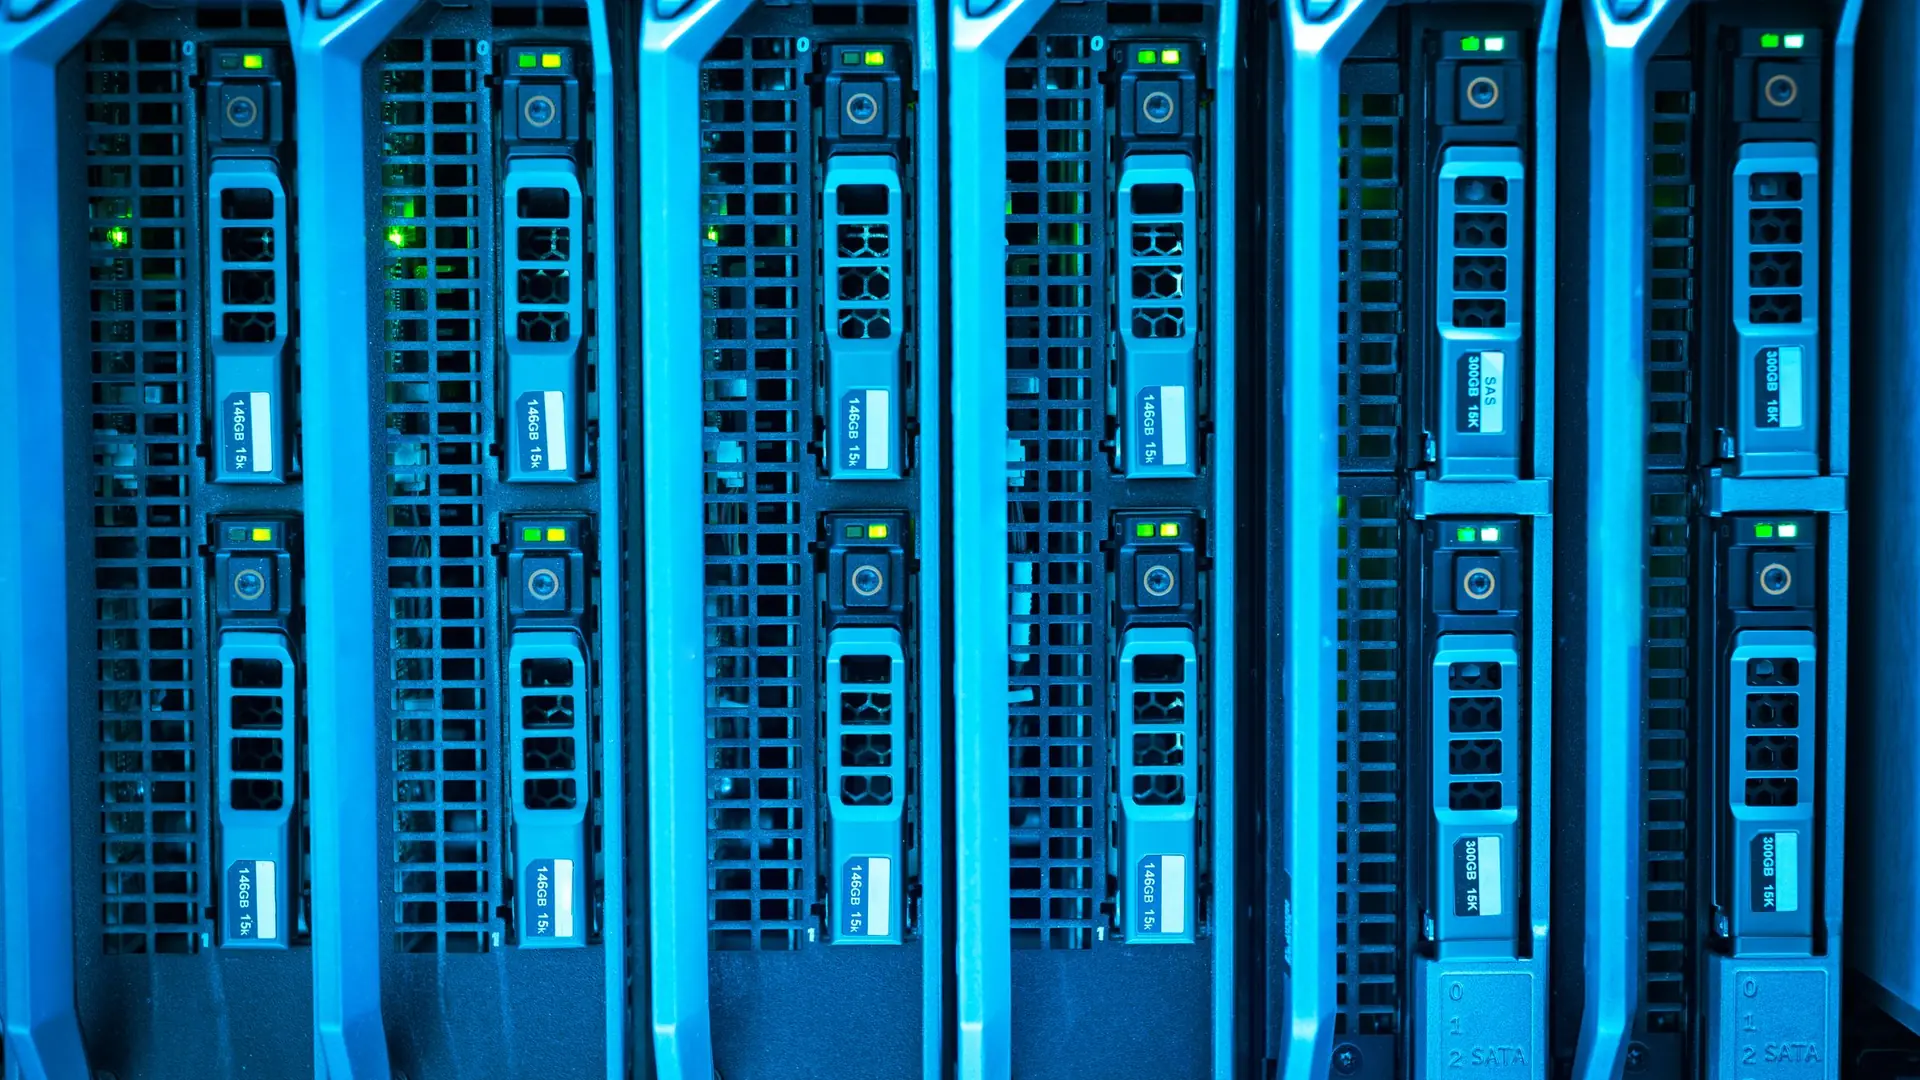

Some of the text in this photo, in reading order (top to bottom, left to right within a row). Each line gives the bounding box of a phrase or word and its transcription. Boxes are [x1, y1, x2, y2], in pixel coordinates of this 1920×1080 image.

[477, 40, 490, 55] 0
[797, 36, 810, 52] 0
[1091, 35, 1104, 51] 0
[1766, 351, 1778, 392] 300GB
[1468, 356, 1479, 428] 300GB 15K
[1484, 376, 1496, 406] SAS
[233, 399, 246, 441] 146GB
[527, 399, 540, 441] 146GB
[848, 397, 860, 439] 146GB
[1143, 394, 1155, 436] 146GB
[1144, 862, 1155, 903] 146GB
[1466, 840, 1478, 911] 300GB 15K
[1763, 836, 1774, 907] 300GB 15K
[238, 867, 250, 908] 146GB
[537, 866, 548, 906] 146GB
[850, 865, 862, 905] 146GB
[201, 932, 209, 947] 1
[491, 931, 500, 947] 1
[807, 927, 815, 942] 1
[1096, 926, 1104, 941] 1
[1449, 981, 1463, 1001] 0
[1743, 977, 1757, 998] 0
[1450, 1016, 1462, 1036] 1
[1743, 1013, 1756, 1033] 1
[1449, 1046, 1527, 1068] 2 SATA
[1742, 1042, 1820, 1064] 2 SATA
